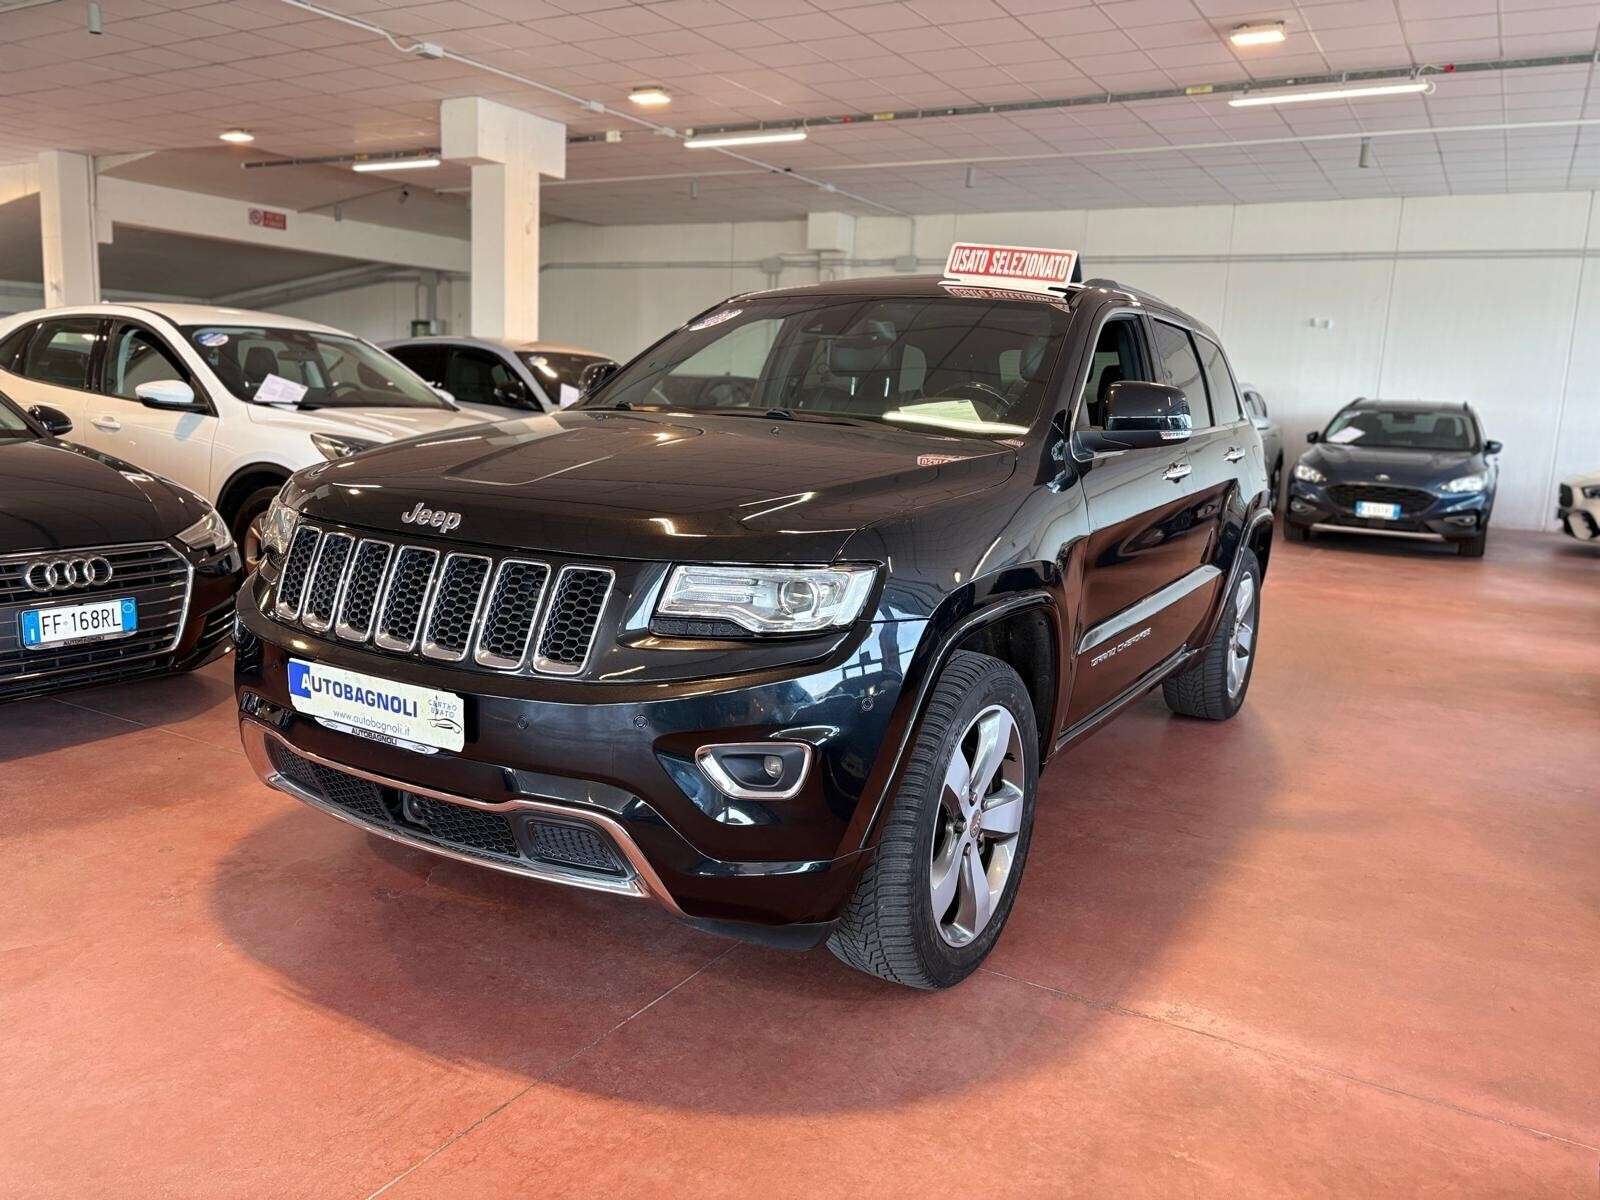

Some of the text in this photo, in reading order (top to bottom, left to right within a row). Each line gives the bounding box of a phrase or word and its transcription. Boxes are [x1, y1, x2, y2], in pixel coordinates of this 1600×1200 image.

[951, 248, 1069, 280] USATO SELEZIONATO
[401, 502, 462, 534] Jeep
[41, 607, 121, 636] FF 168RL
[300, 673, 418, 718] AUTOBAGNOLI
[333, 709, 411, 737] www.autobagnoli.it
[351, 727, 398, 746] AUTOBAGNOLI
